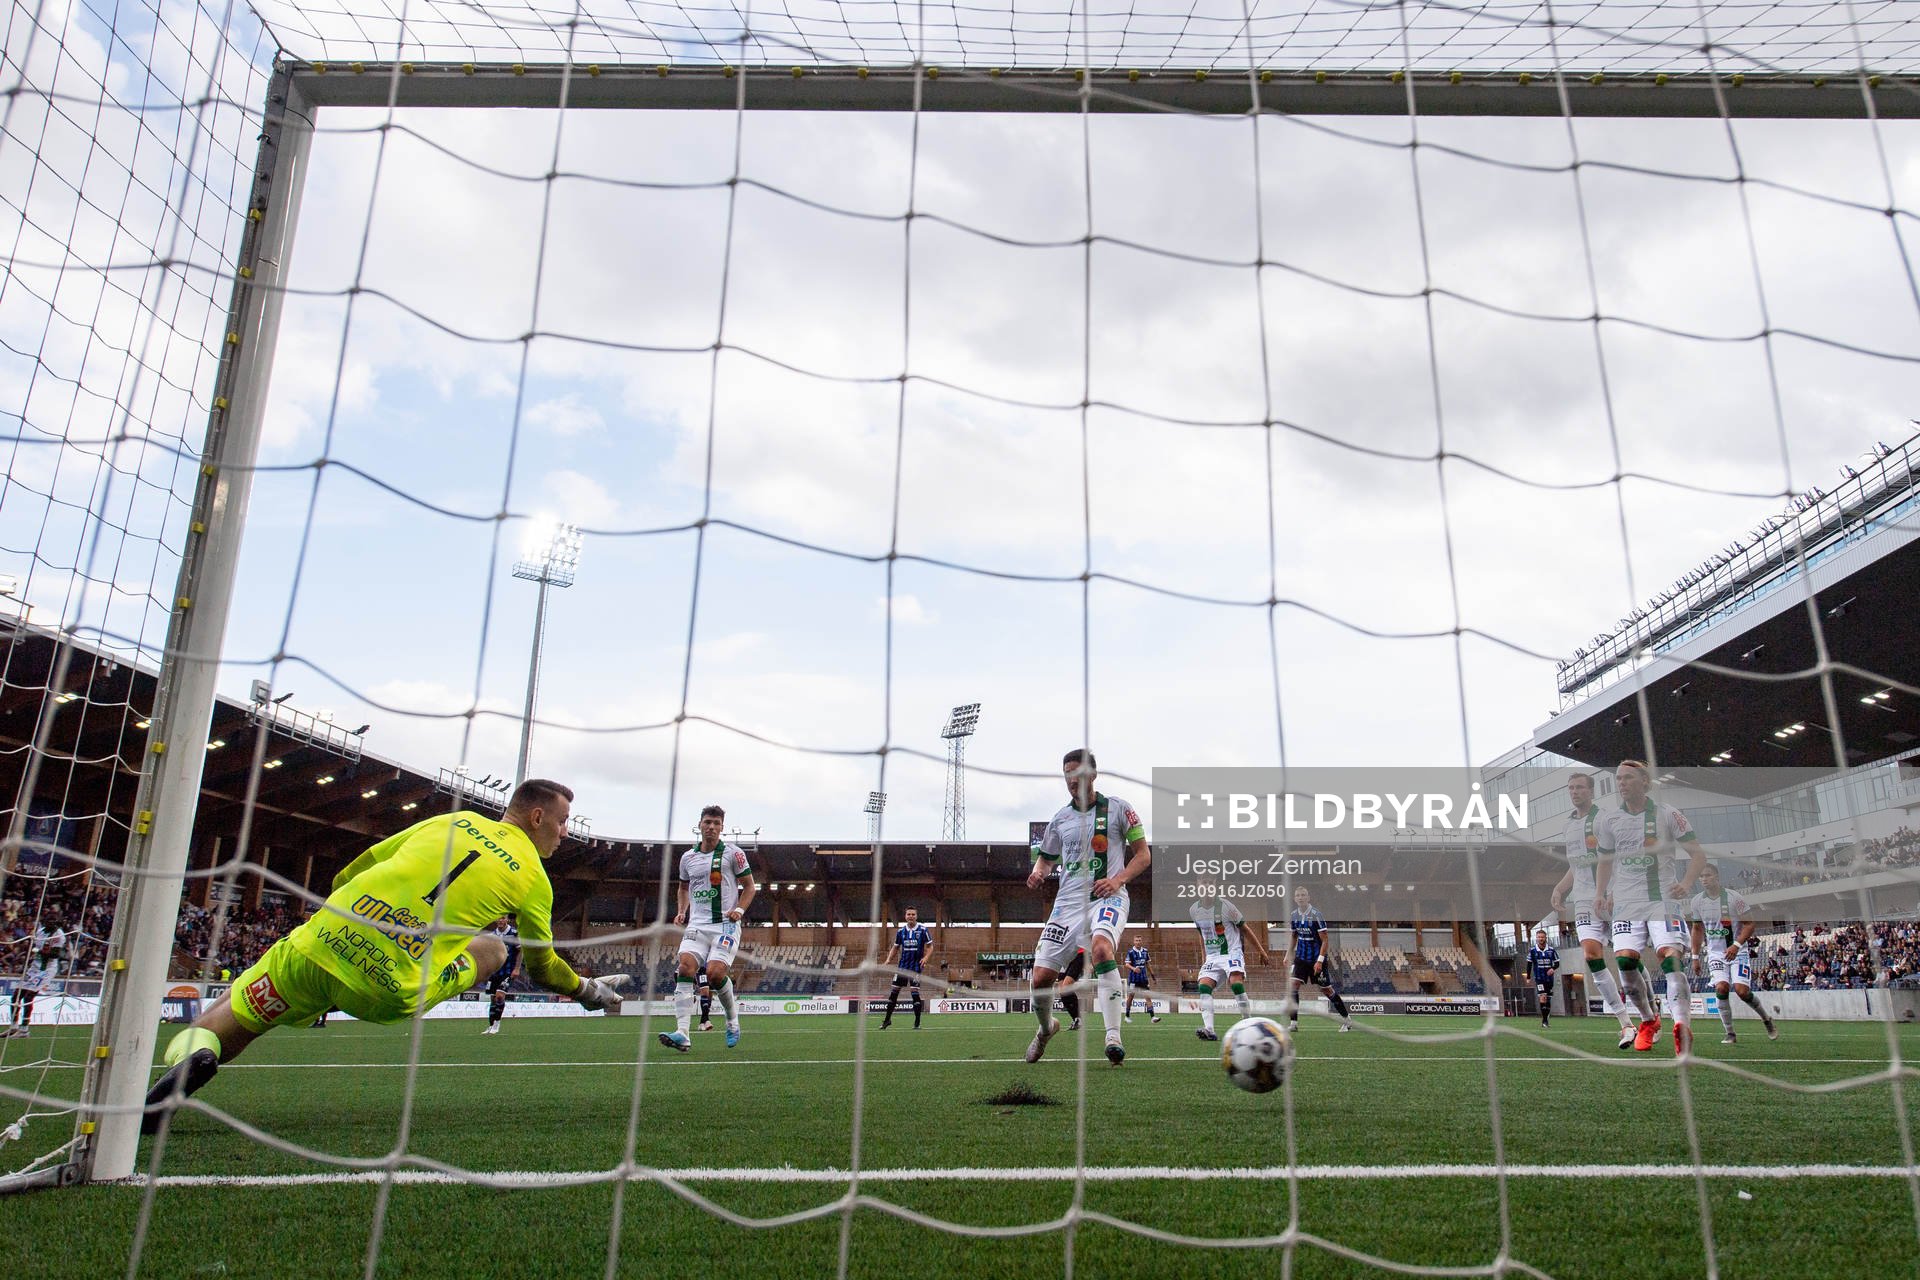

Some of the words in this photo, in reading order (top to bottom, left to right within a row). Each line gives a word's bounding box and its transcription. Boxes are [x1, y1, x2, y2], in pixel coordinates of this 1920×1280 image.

[453, 818, 520, 872] Derome
[421, 849, 483, 907] 1
[317, 926, 402, 993] WELLNESS
[338, 925, 398, 972] NORDIC
[252, 975, 287, 1013] FMP
[801, 1002, 827, 1011] mella
[950, 1002, 995, 1011] BYGMA
[1350, 1003, 1384, 1011] colorama
